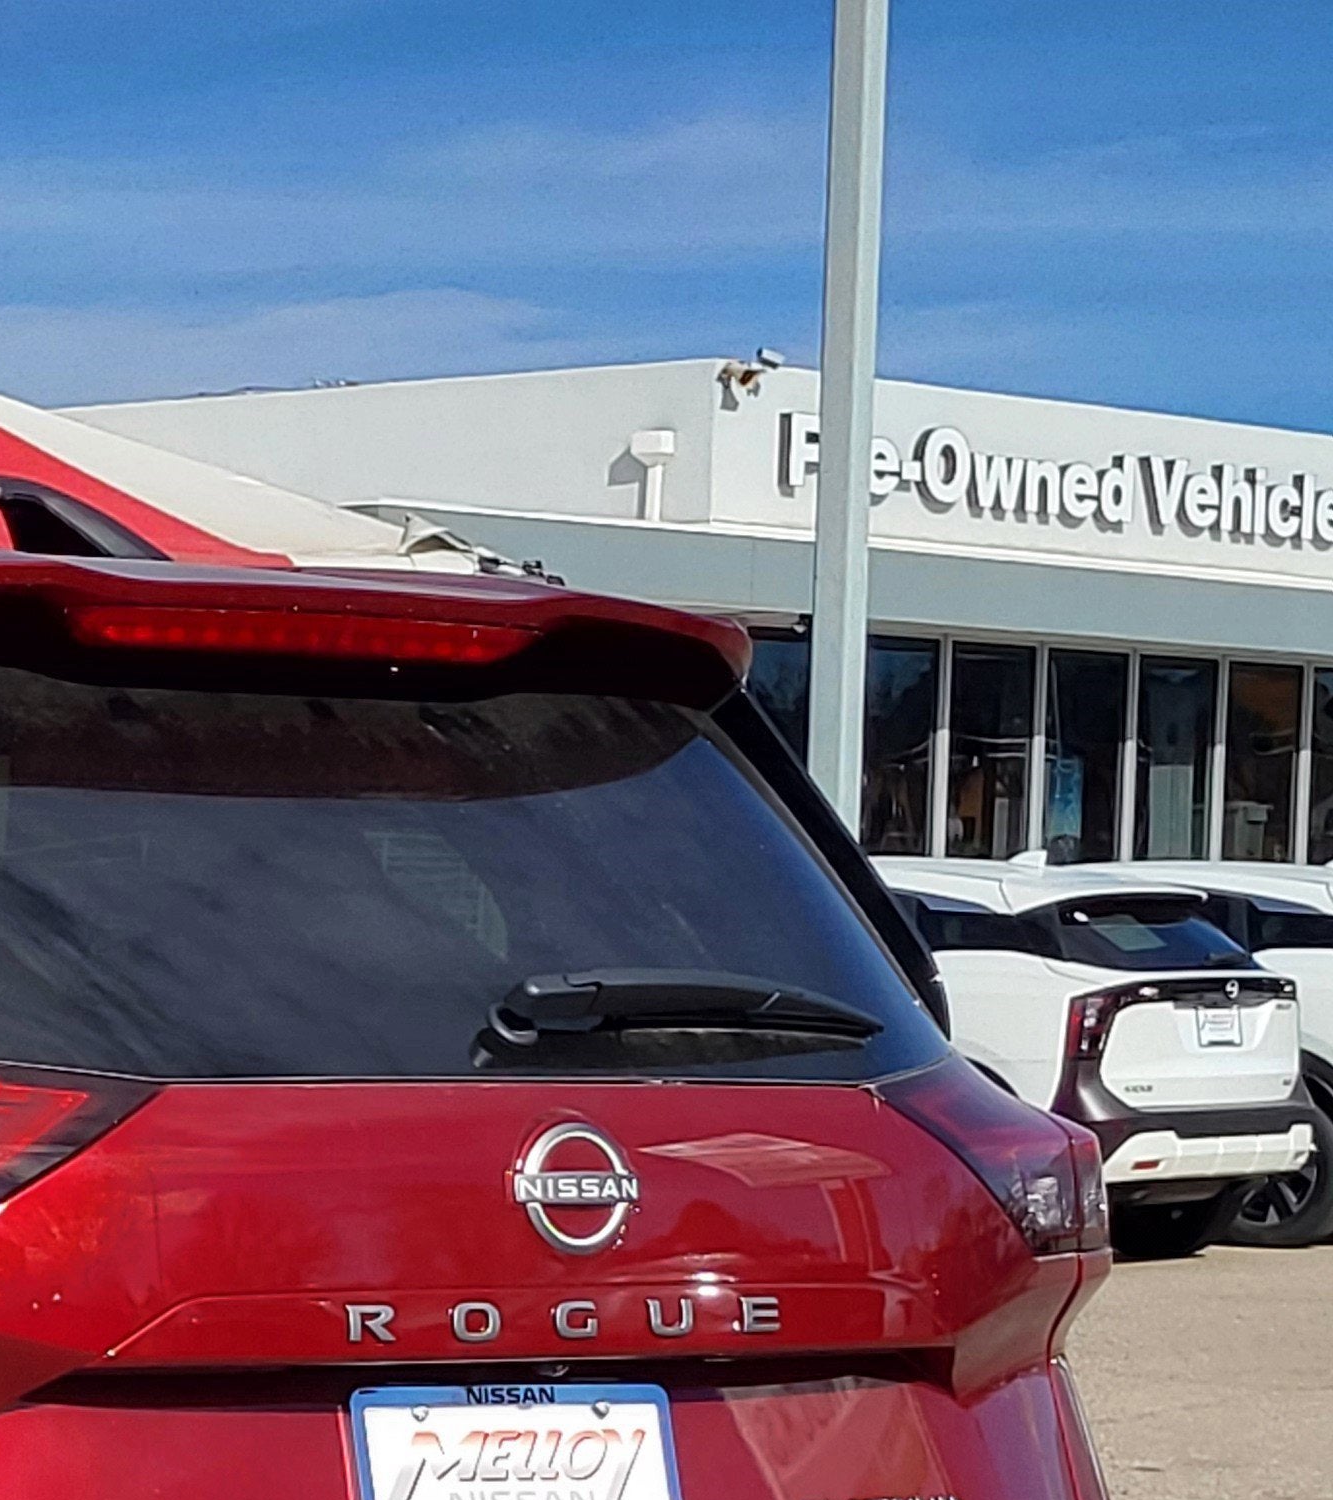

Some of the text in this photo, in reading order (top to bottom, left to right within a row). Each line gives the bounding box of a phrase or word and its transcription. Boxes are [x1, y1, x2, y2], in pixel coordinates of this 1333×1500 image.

[781, 411, 1134, 526] Pe-Owned
[517, 1175, 639, 1201] NISSAN
[345, 1296, 781, 1342] ROGUE
[466, 1386, 556, 1405] NISSAN
